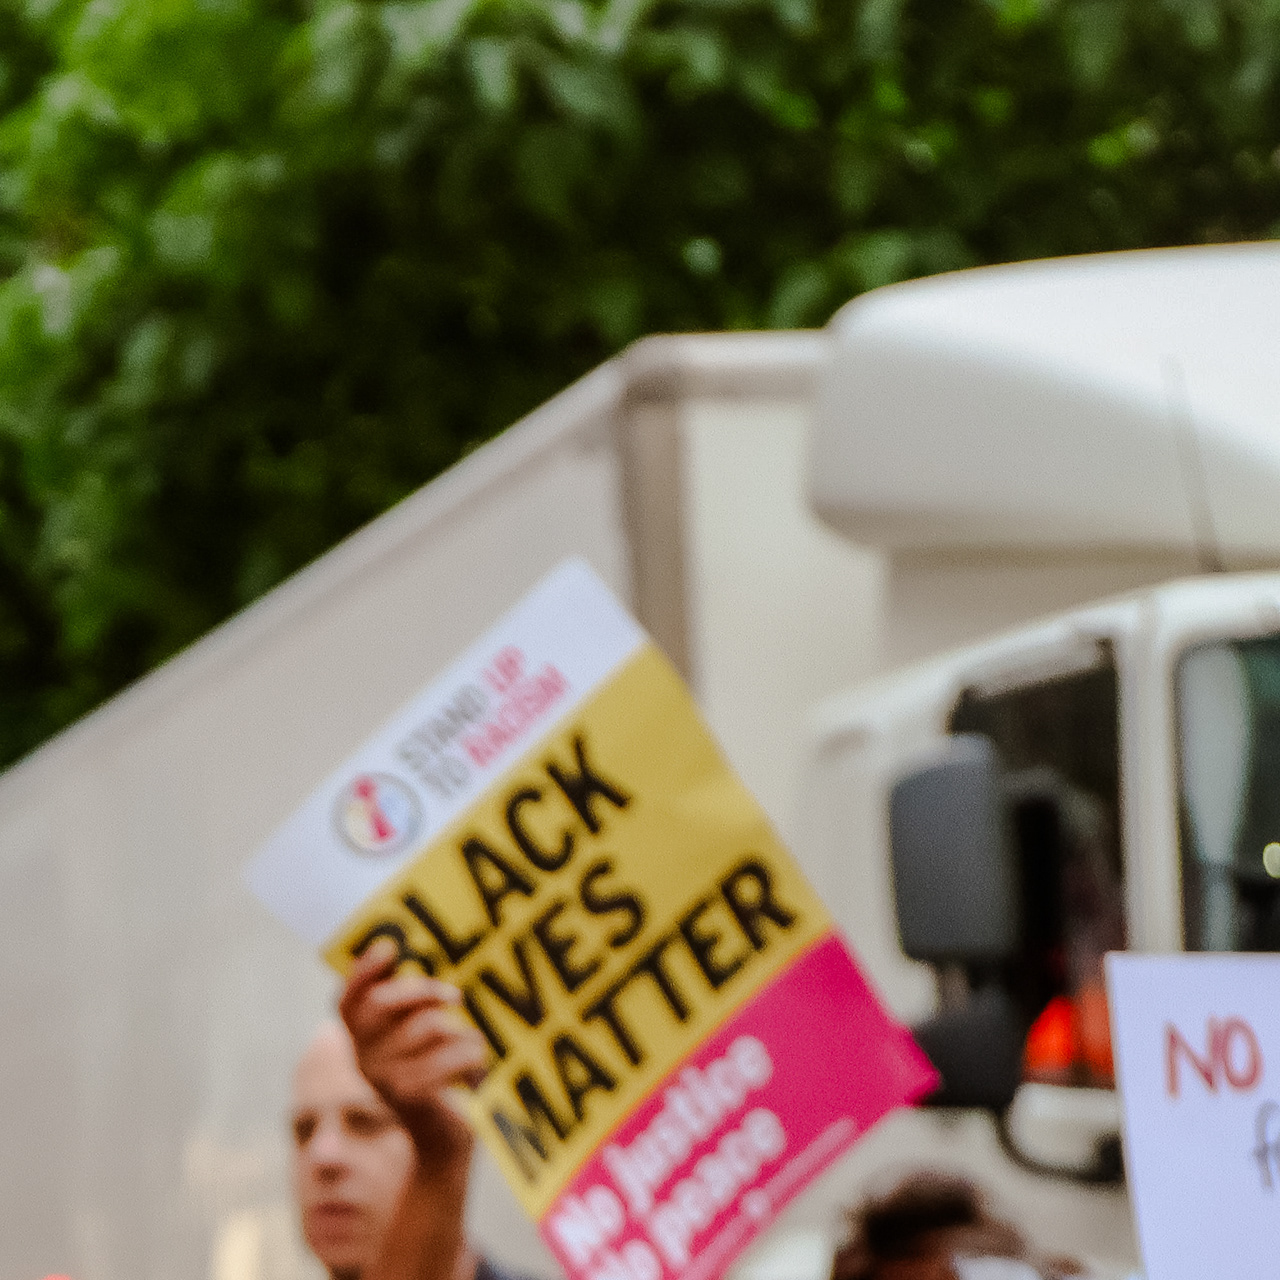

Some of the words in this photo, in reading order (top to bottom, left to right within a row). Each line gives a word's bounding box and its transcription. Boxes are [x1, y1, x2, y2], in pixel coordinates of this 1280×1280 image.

[492, 853, 796, 1186] MATTER
[1163, 1015, 1265, 1100] NO
[552, 1185, 625, 1269] No
